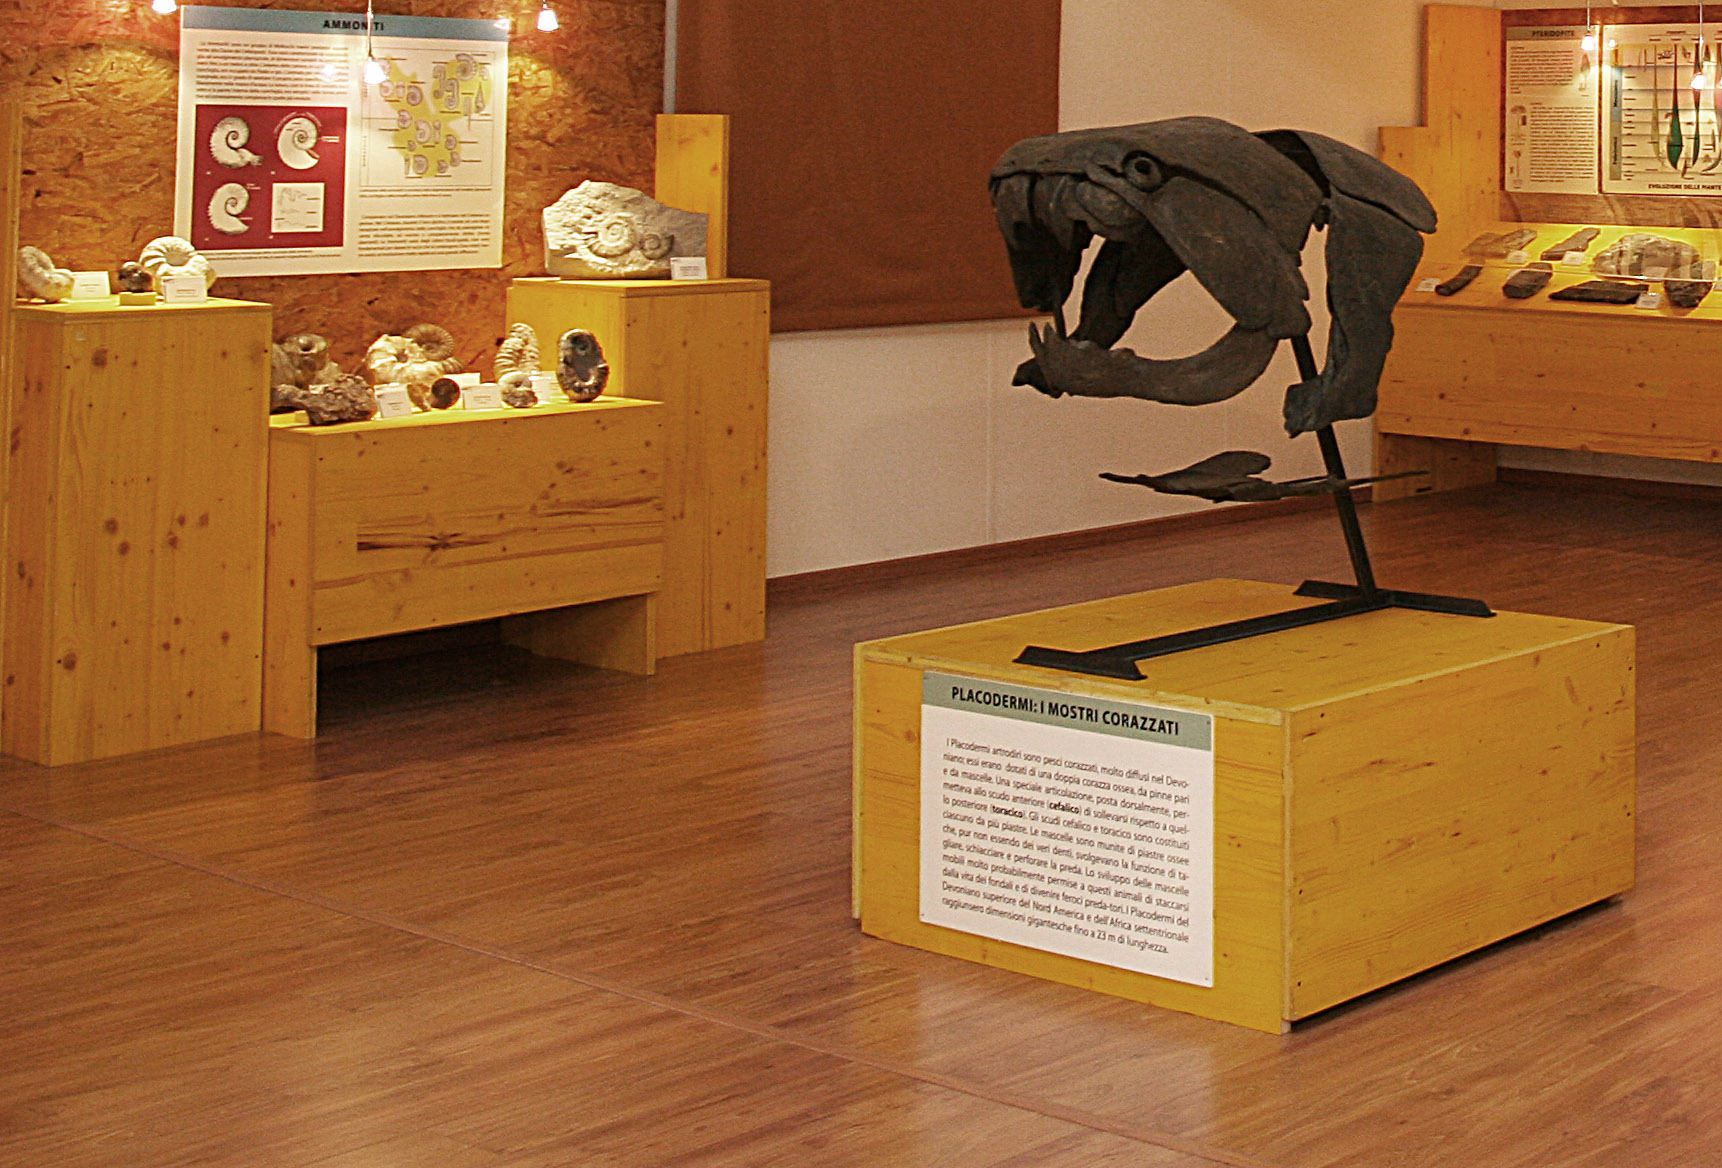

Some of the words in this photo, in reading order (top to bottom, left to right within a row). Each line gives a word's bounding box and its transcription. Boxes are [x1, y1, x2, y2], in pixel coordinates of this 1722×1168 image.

[323, 20, 384, 31] AMMONTI
[951, 686, 1037, 712] PLACODERMI:
[1040, 699, 1045, 714] I
[1047, 701, 1099, 722] MOSTRI
[1102, 710, 1179, 735] CORAZZATI
[950, 738, 991, 753] Placodermi
[1023, 753, 1042, 763] sono
[1042, 756, 1063, 766] pesci
[1100, 766, 1124, 777] molto
[1125, 769, 1150, 781] diffusi
[1151, 774, 1164, 784] nel
[1165, 775, 1189, 788] Devo-
[965, 757, 980, 766] essi
[980, 760, 1002, 770] erano
[1004, 763, 1027, 775] dotati
[1028, 766, 1036, 777] di
[1037, 770, 1052, 779] una
[1053, 771, 1081, 785] doppia
[1081, 778, 1111, 790] corazza
[1136, 786, 1148, 796] da
[1148, 789, 1172, 801] pinne
[1173, 794, 1190, 804] pari
[942, 782, 972, 794] metteva
[973, 786, 987, 797] allo
[987, 790, 1010, 801] scudo
[1011, 795, 1045, 808] anteriore
[1046, 799, 1082, 816] (cefalico)
[1083, 806, 1092, 816] di
[1092, 809, 1129, 823] sollevarsi
[1129, 816, 1161, 829] rispetto
[1168, 824, 1189, 834] quel-
[949, 767, 959, 777] da
[995, 775, 1011, 787] Una
[1012, 780, 1042, 793] speciale
[1095, 795, 1118, 807] posta
[1172, 809, 1189, 819] per-
[942, 794, 950, 804] lo
[951, 798, 988, 812] posteriore
[1028, 811, 1039, 821] Gli
[1040, 815, 1061, 825] scudi
[1062, 818, 1092, 831] cefalico
[1100, 825, 1132, 839] toracico
[1133, 832, 1153, 843] sono
[1154, 836, 1189, 850] costituiti
[942, 810, 974, 823] ciascuno
[975, 815, 986, 826] da
[986, 818, 1000, 829] più
[1029, 825, 1039, 836] Le
[1040, 830, 1074, 843] mascelle
[1075, 836, 1095, 847] sono
[1096, 841, 1125, 853] munite
[1126, 845, 1136, 855] di
[1137, 848, 1165, 861] piastre
[1166, 854, 1189, 865] ossee
[958, 828, 972, 838] pur
[972, 831, 988, 840] non
[989, 834, 1020, 847] essendo
[1021, 839, 1034, 850] dei
[1035, 844, 1050, 853] veri
[1075, 851, 1120, 867] svolgevano
[1121, 858, 1129, 869] la
[1130, 860, 1165, 876] funzione
[1167, 868, 1176, 878] di
[1177, 871, 1189, 880] ta-
[965, 844, 1005, 859] schiacciare
[1013, 854, 1048, 868] perforare
[1049, 859, 1058, 870] la
[1084, 866, 1095, 877] Lo
[1097, 870, 1131, 885] sviluppo
[1132, 876, 1152, 889] delle
[1154, 883, 1189, 896] mascelle
[942, 854, 965, 865] mobili
[966, 859, 989, 870] molto
[990, 864, 1045, 882] probabilmente
[1047, 876, 1078, 889] permise
[1086, 884, 1111, 896] questi
[1113, 889, 1143, 902] animali
[1144, 894, 1153, 904] di
[1155, 898, 1189, 911] staccarsi
[942, 867, 959, 879] dalla
[960, 871, 974, 882] vita
[975, 874, 987, 885] dei
[987, 876, 1013, 890] fondali
[1020, 883, 1029, 893] di
[1029, 885, 1060, 900] divenire
[1061, 891, 1084, 905] feroci
[1130, 906, 1175, 924] Placodermi
[1176, 916, 1189, 927] del
[941, 881, 981, 897] Devoniano
[982, 891, 1017, 906] superiore
[1018, 898, 1031, 908] del
[1032, 900, 1052, 913] Nord
[1052, 905, 1085, 920] America
[1134, 924, 1189, 942] settentrionale
[985, 905, 1026, 922] dimensioni
[1026, 915, 1072, 933] gigantesche
[1073, 924, 1089, 936] fino
[1096, 929, 1107, 940] 23
[1116, 934, 1125, 944] di
